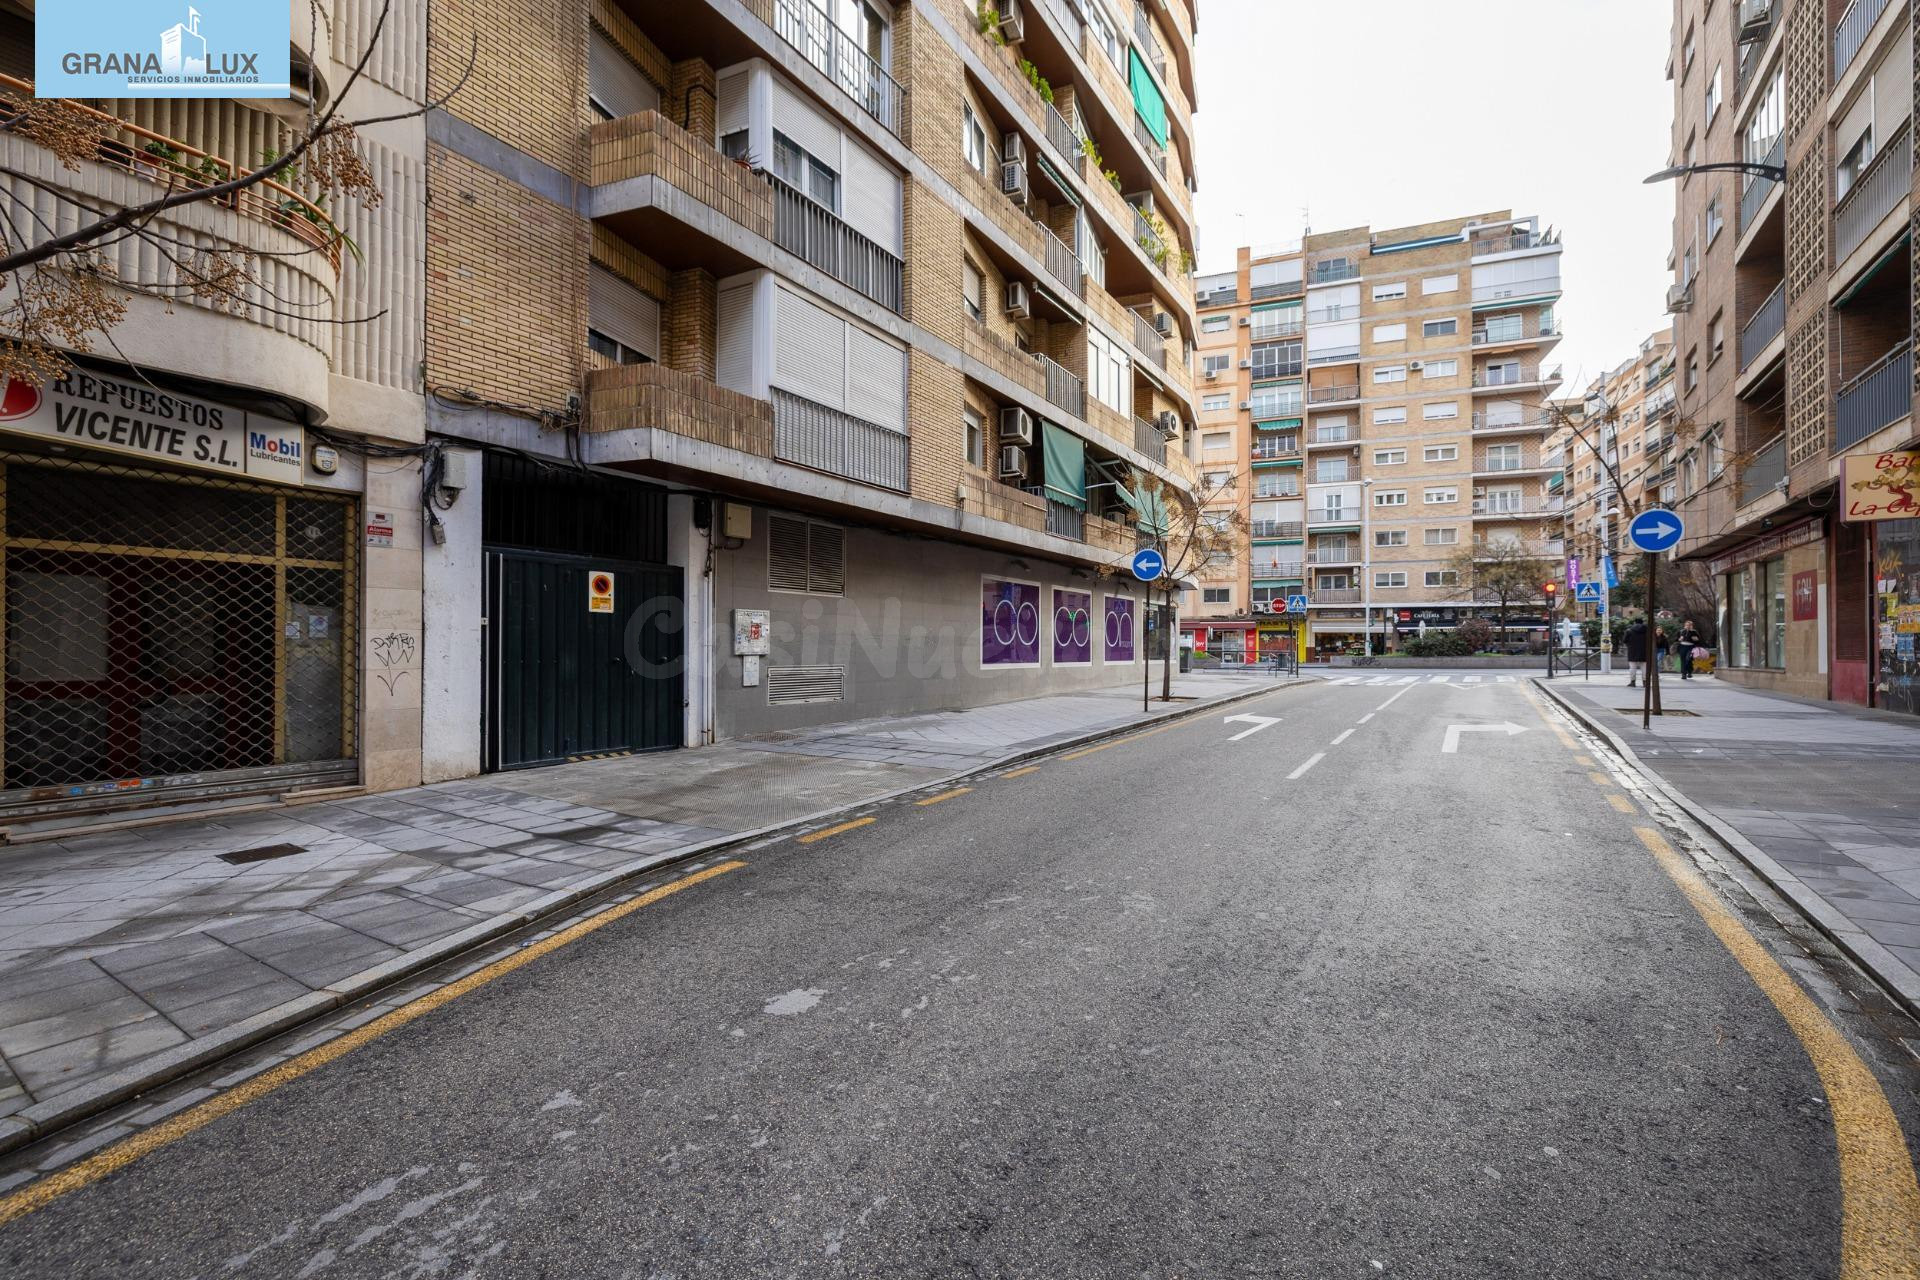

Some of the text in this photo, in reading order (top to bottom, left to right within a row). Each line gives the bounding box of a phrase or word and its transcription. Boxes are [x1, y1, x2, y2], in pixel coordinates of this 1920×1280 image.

[52, 370, 224, 431] REPUESTOS
[54, 402, 238, 467] VICENTE S.L.
[250, 431, 301, 458] Mobil
[250, 448, 301, 467] Lubricantes
[1849, 501, 1878, 516] La
